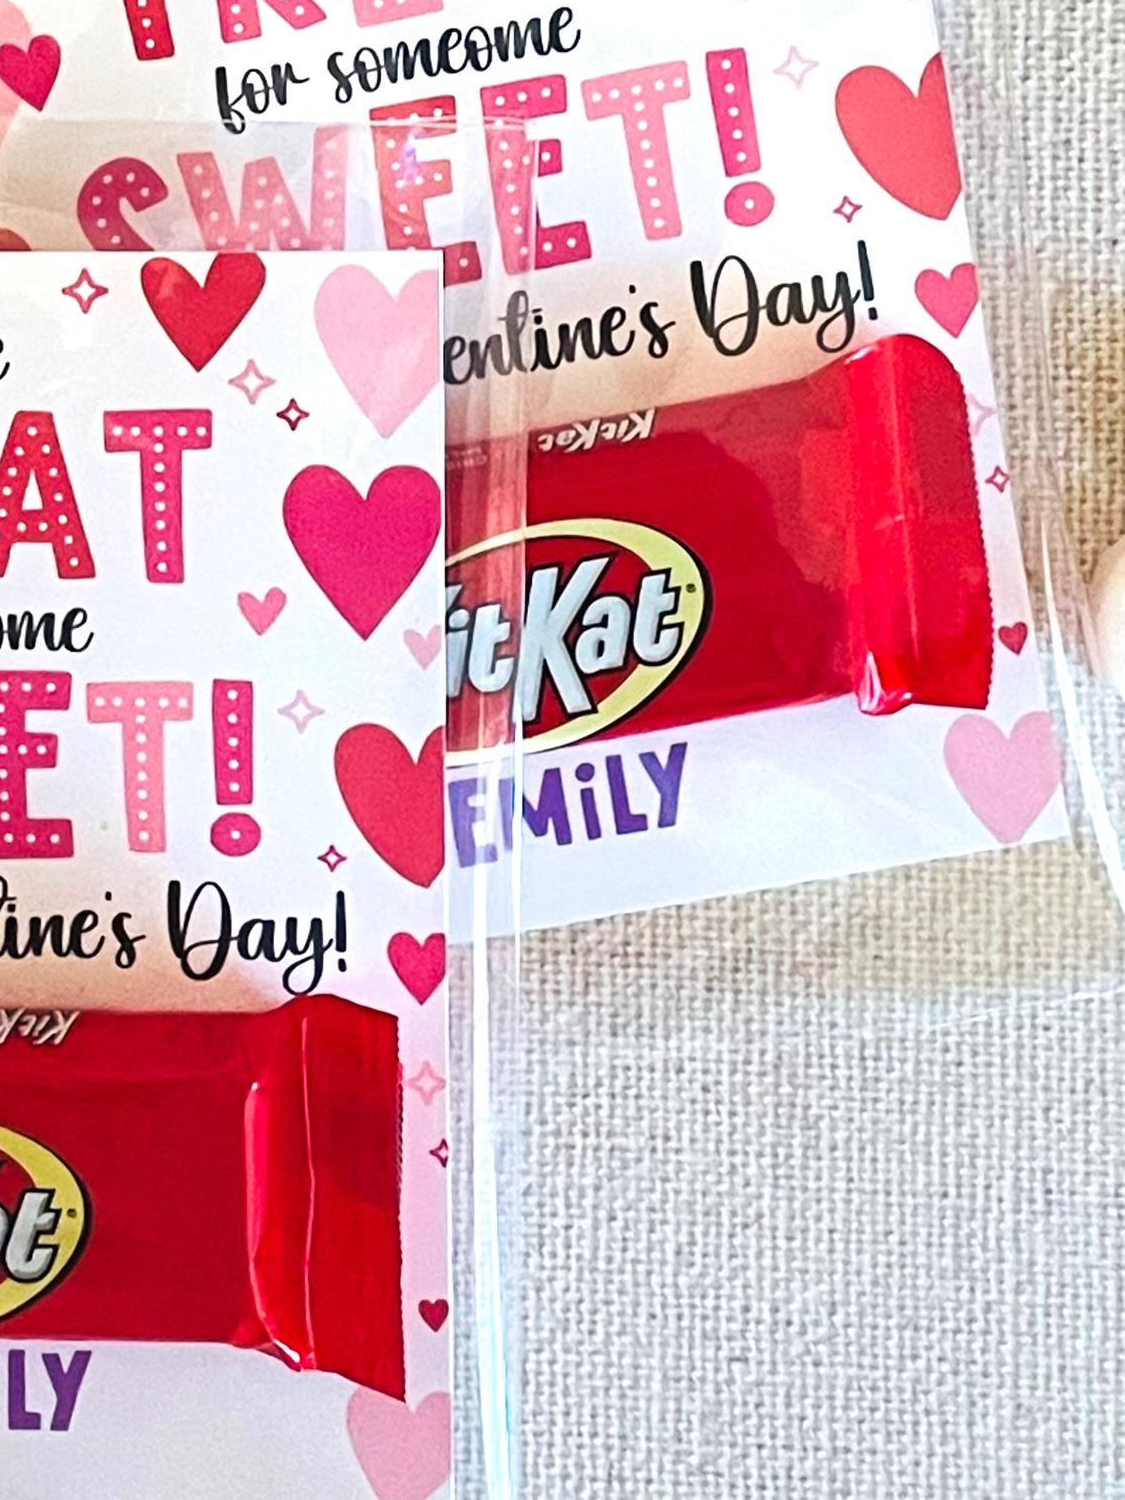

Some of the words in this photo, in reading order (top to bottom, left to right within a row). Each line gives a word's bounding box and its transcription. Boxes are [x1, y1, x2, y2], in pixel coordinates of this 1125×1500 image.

[215, 63, 310, 135] for
[443, 284, 676, 386] entine's
[689, 239, 879, 357] Day!
[446, 552, 686, 724] itKat
[166, 879, 351, 996] Day!
